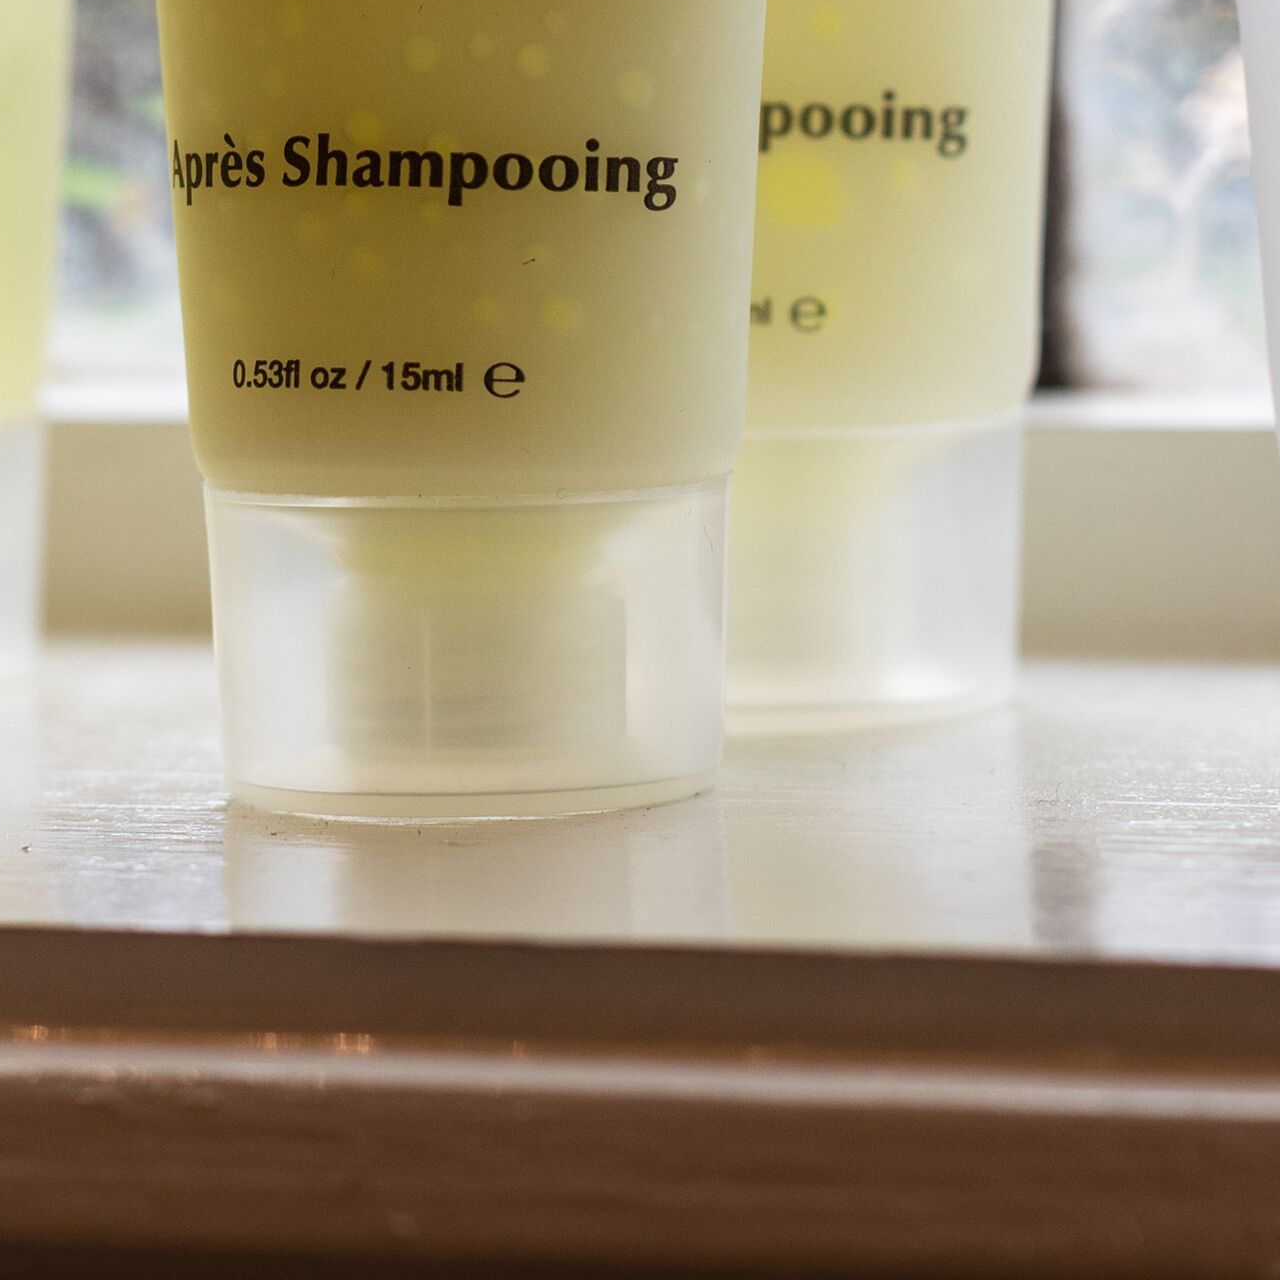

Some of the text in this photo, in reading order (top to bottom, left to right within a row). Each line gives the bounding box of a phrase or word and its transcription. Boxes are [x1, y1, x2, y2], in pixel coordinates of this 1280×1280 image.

[172, 132, 679, 211] Après Shampooing
[233, 358, 301, 389] 0.53fl
[310, 366, 347, 390] oz
[355, 359, 372, 391] /
[381, 361, 464, 392] 15ml
